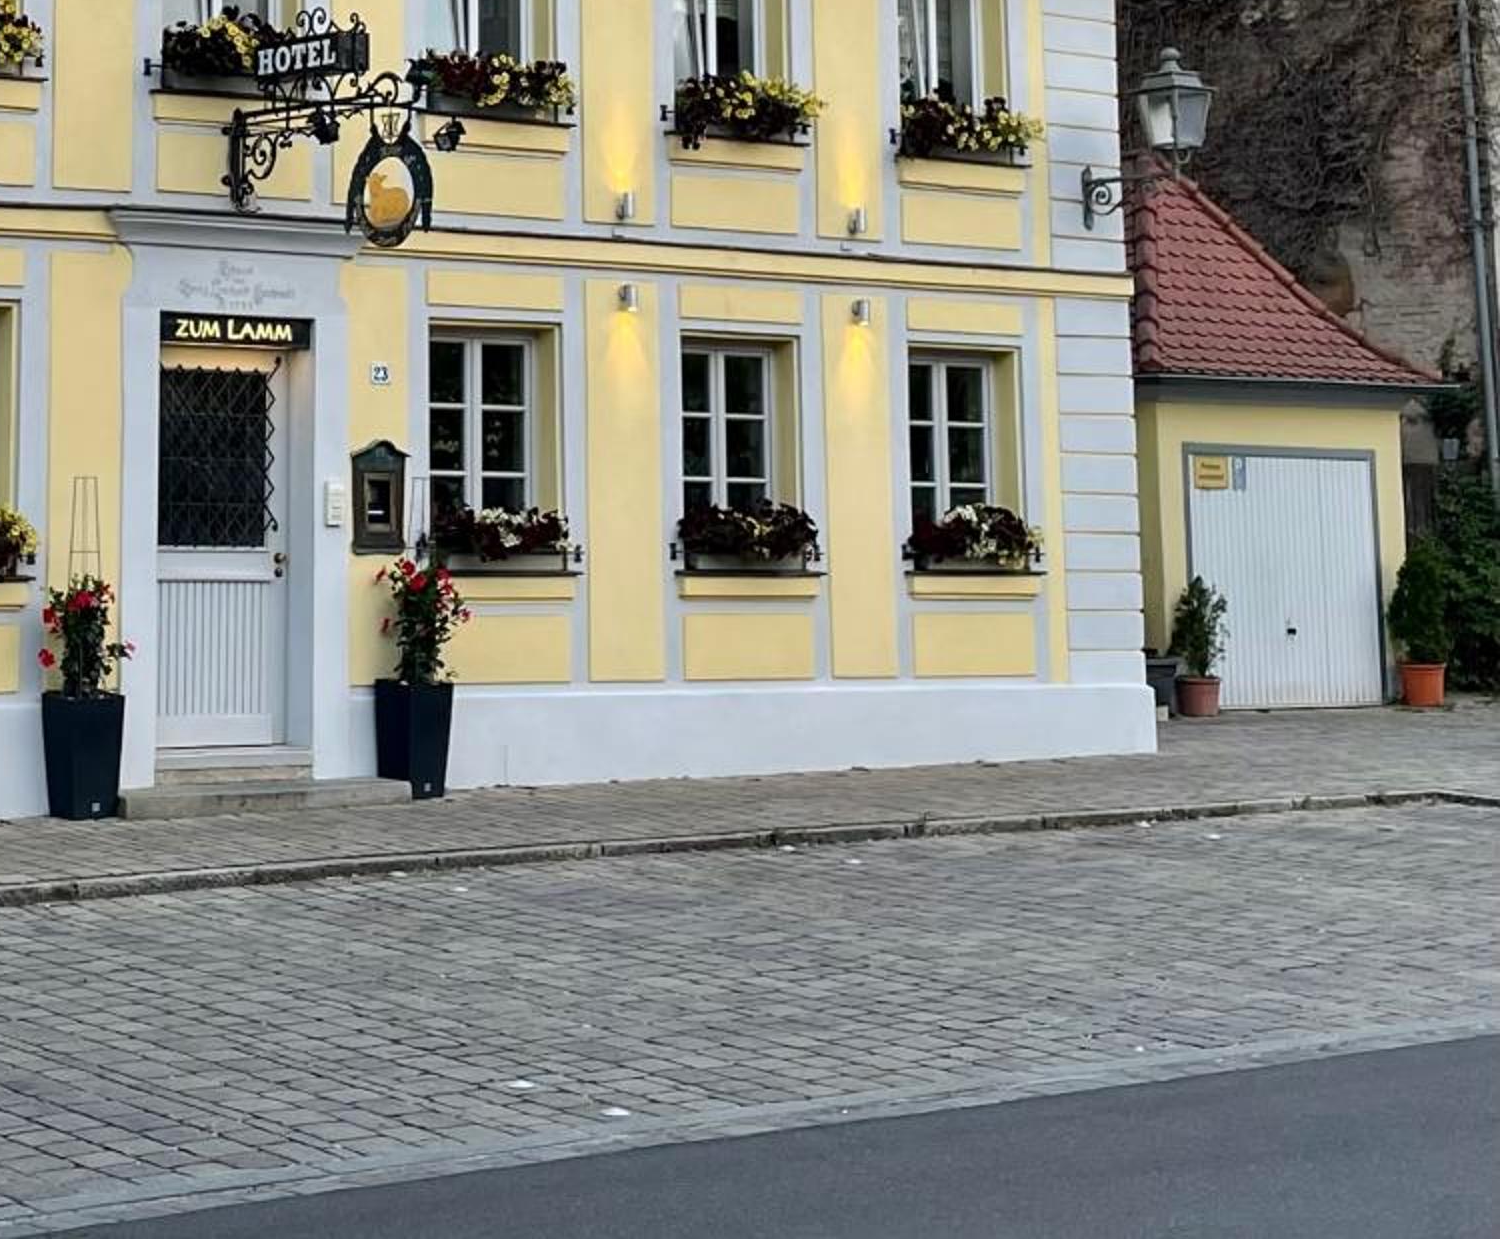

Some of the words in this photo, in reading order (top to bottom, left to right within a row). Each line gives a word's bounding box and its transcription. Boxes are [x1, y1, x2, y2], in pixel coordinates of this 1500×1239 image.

[258, 39, 336, 75] HOTEL
[175, 319, 221, 338] ZUM
[227, 318, 292, 341] LAMM
[373, 366, 388, 382] 23
